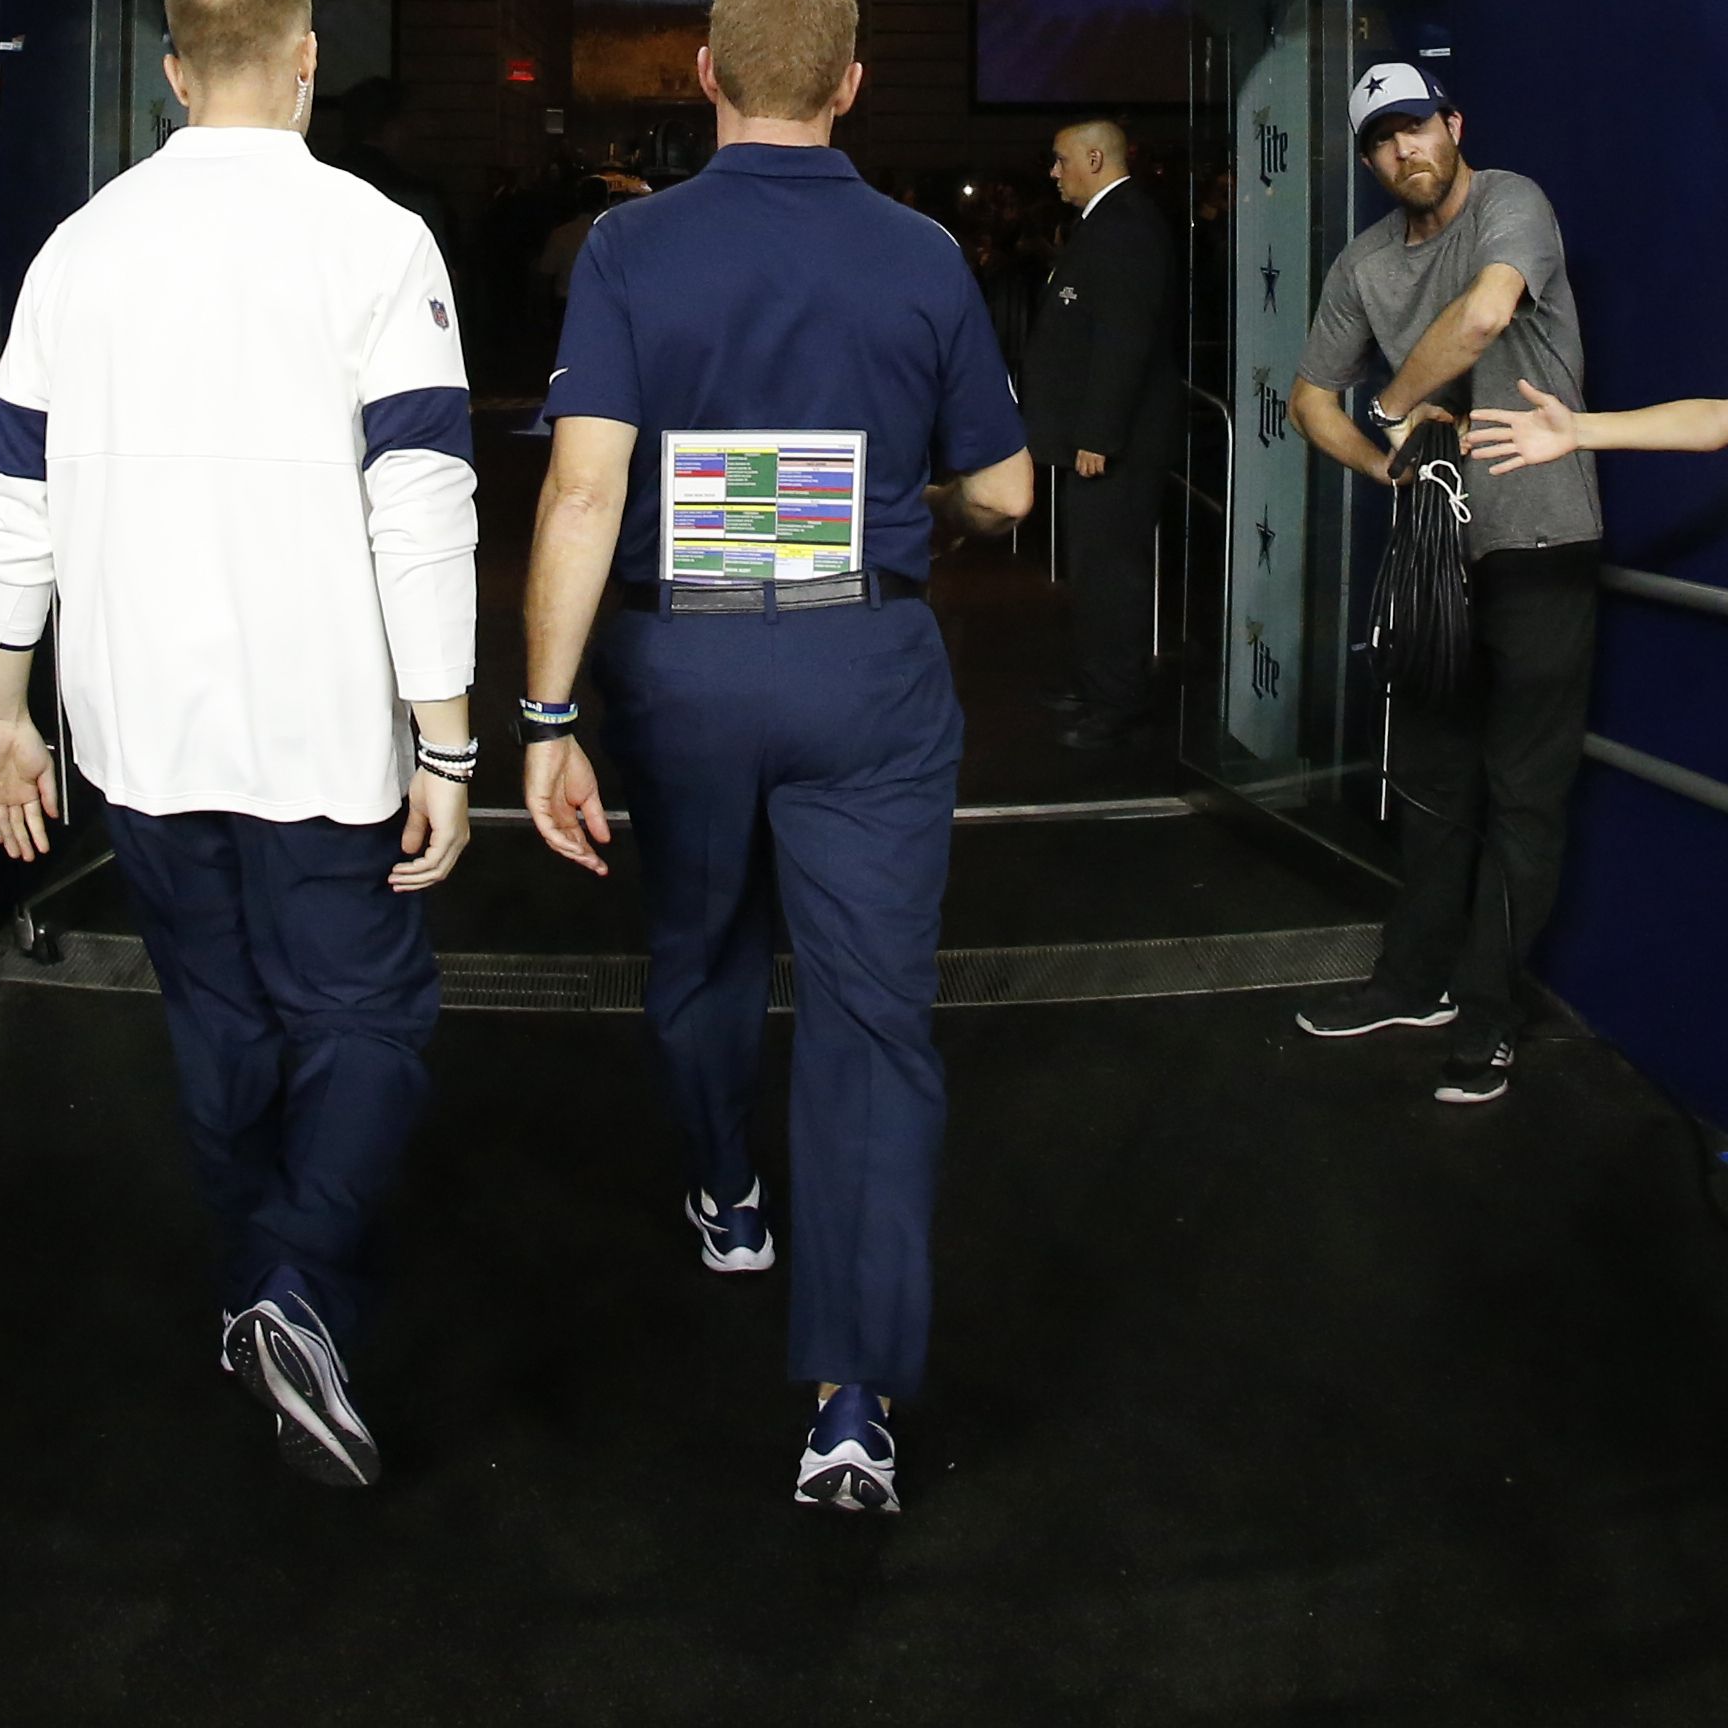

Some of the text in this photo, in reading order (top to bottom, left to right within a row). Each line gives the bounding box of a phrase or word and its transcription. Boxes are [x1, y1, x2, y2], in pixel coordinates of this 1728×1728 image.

[1258, 125, 1289, 187] Lite
[1258, 383, 1287, 448] Lite
[1251, 635, 1280, 701] Lite
